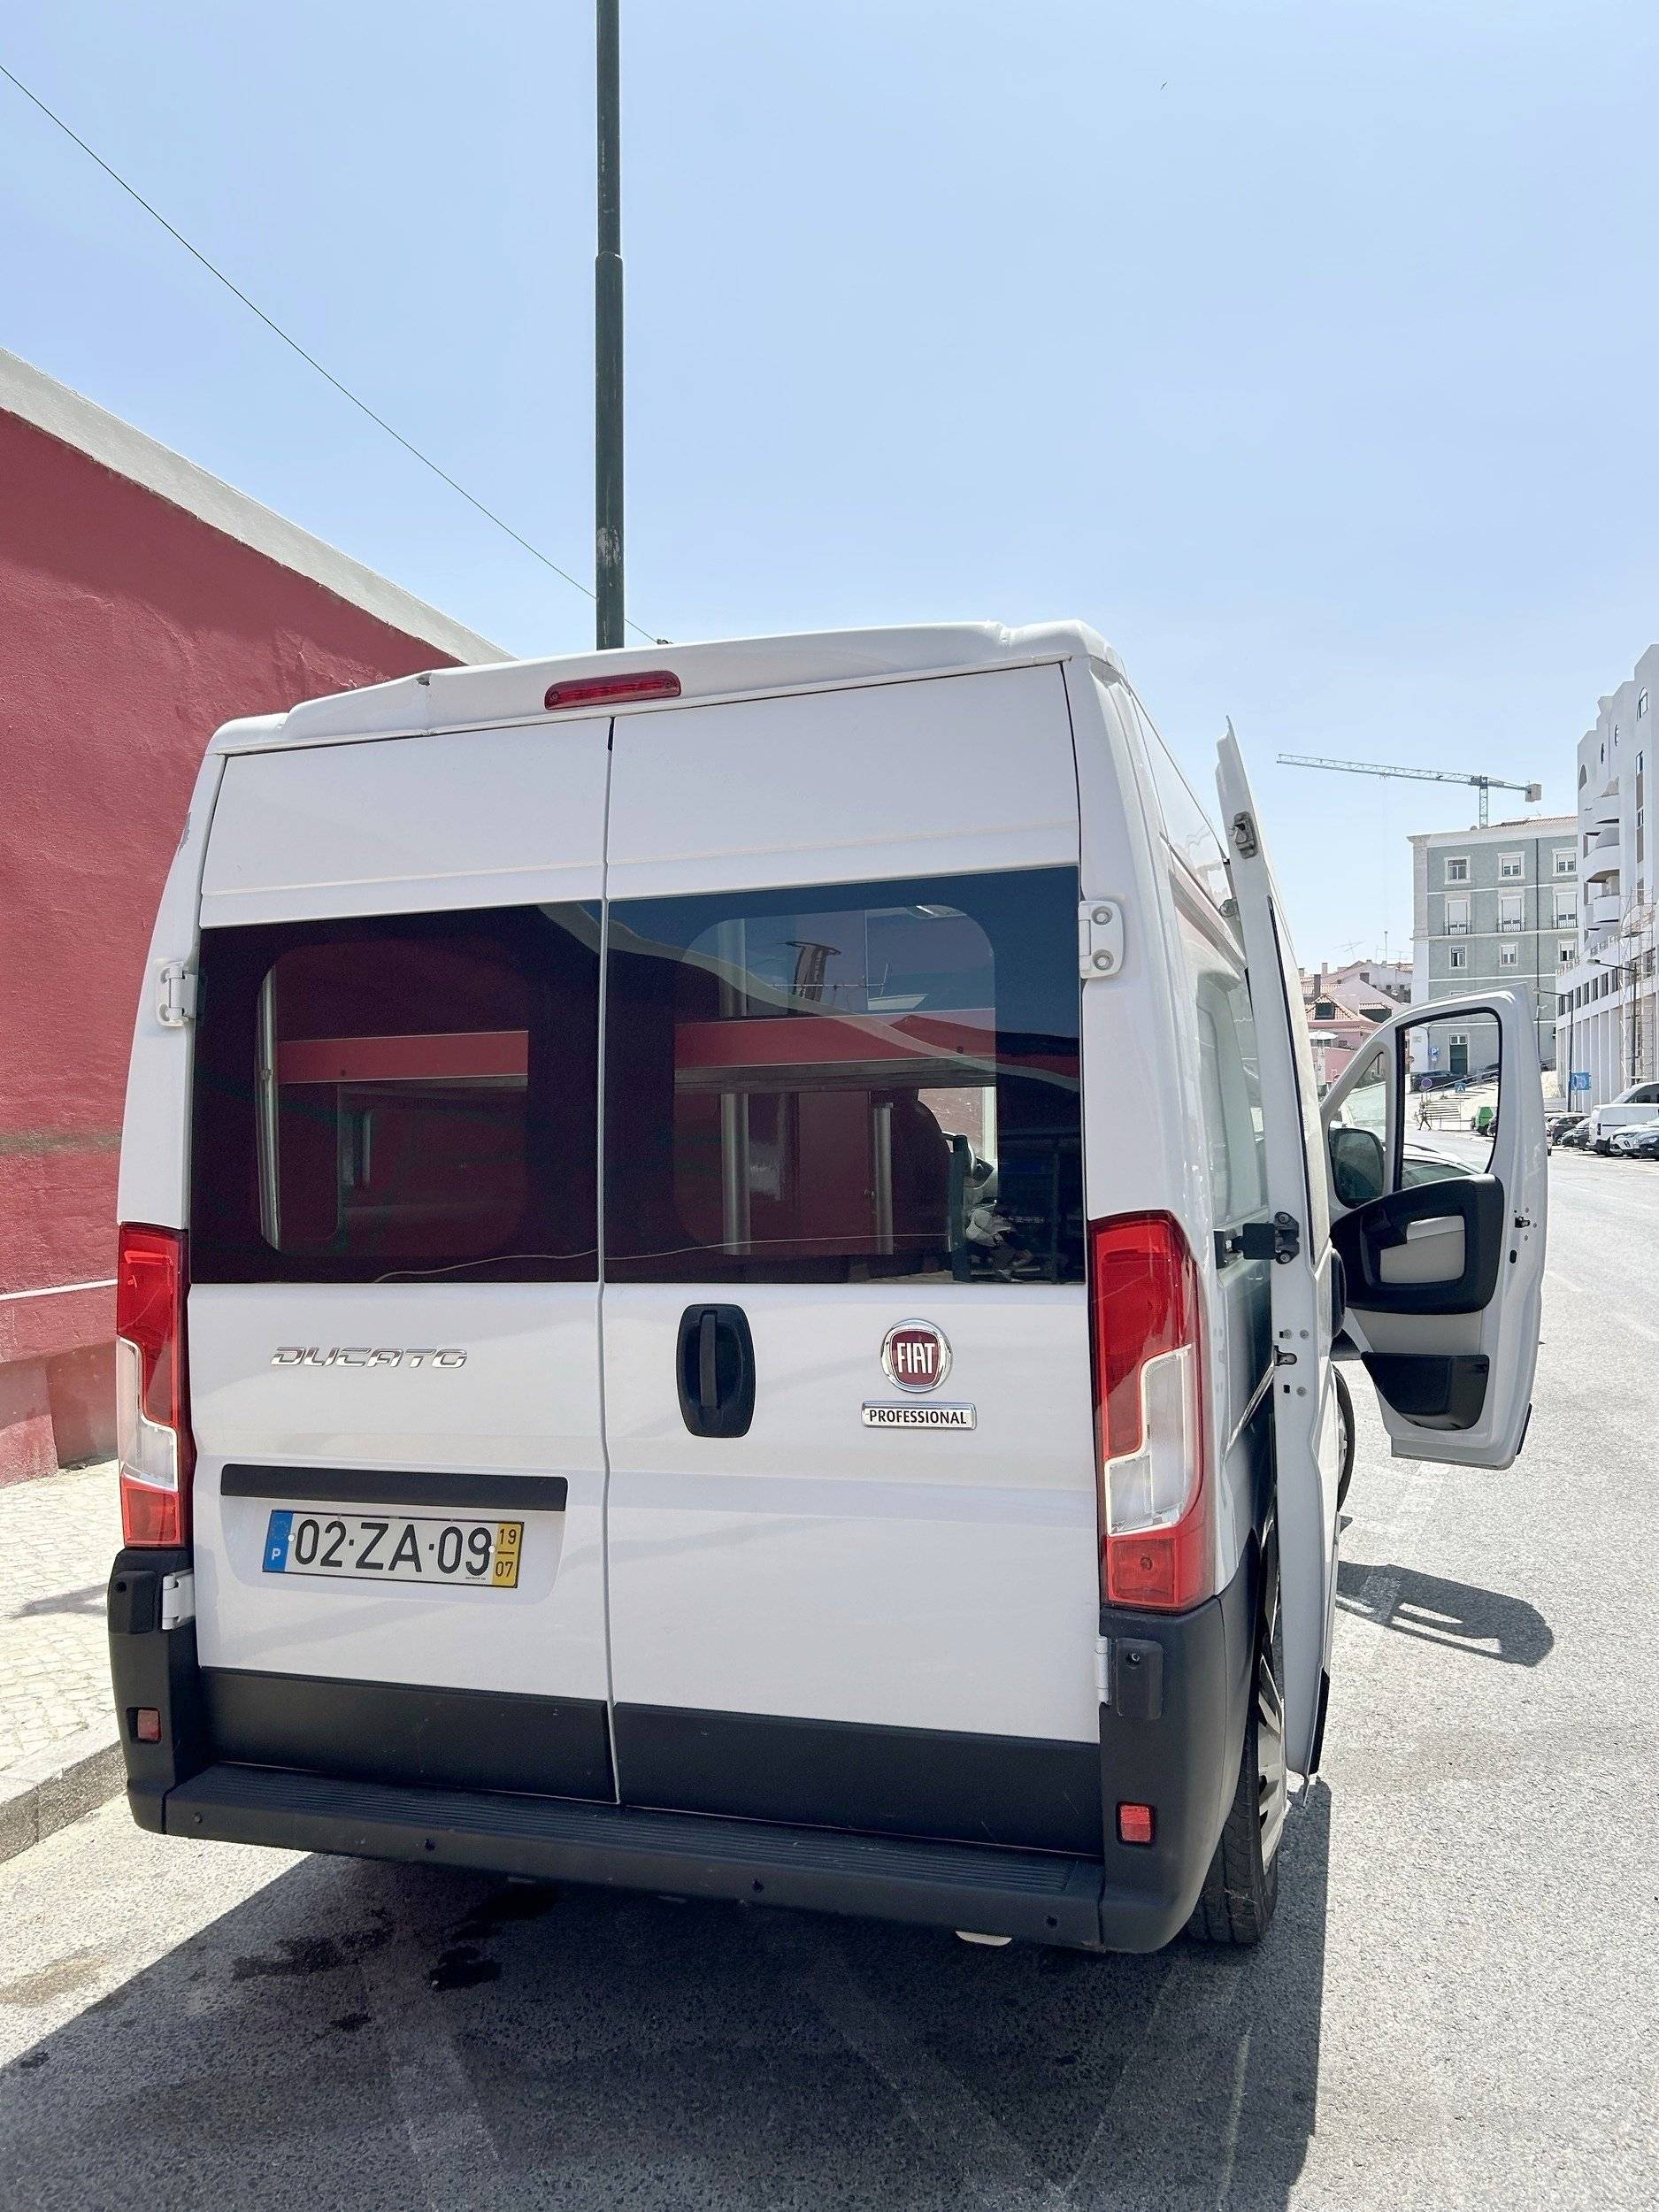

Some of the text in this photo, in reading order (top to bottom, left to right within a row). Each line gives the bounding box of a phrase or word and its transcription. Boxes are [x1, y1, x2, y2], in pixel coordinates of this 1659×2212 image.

[270, 1347, 468, 1368] DUCATO
[896, 1342, 935, 1374] FIAT
[869, 1409, 967, 1425] PROFESSIONAL
[499, 1528, 517, 1545] 19
[271, 1548, 281, 1561] P
[495, 1560, 514, 1577] 07
